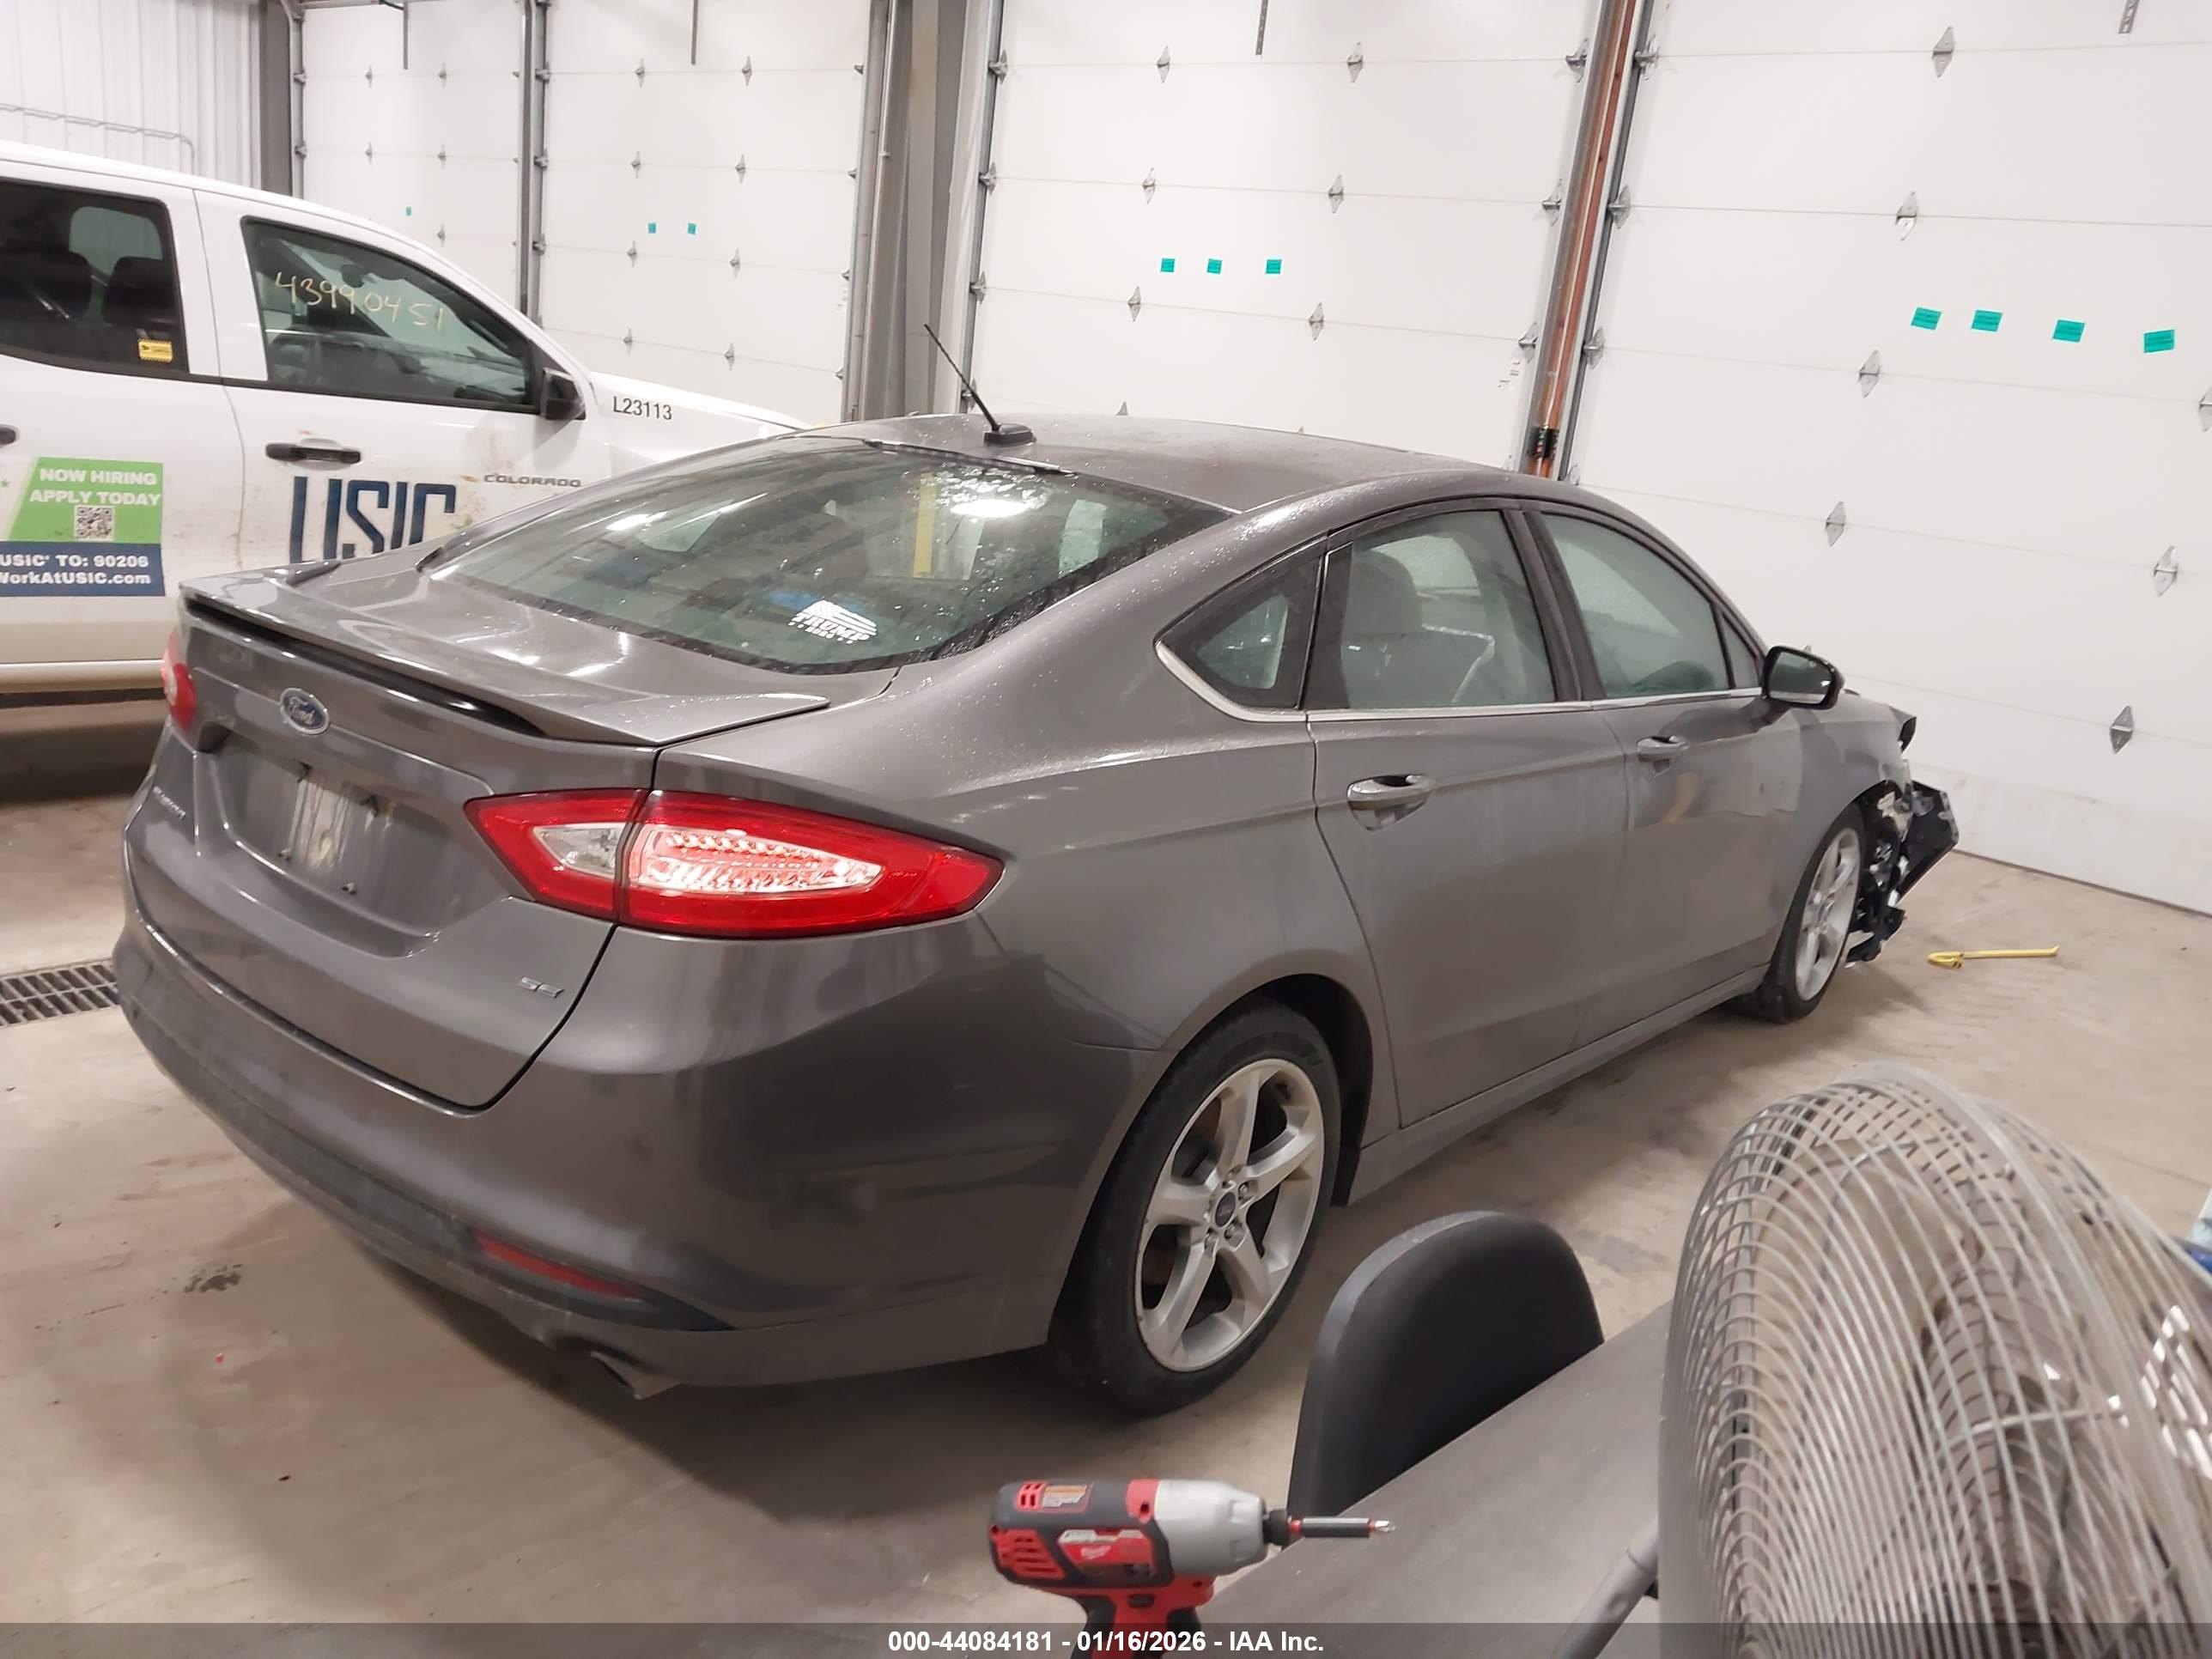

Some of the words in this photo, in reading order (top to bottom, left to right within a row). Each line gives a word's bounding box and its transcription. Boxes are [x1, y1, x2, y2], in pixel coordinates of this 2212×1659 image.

[275, 271, 443, 331] 43990451
[613, 396, 672, 420] L23113
[40, 468, 87, 483] NOW
[91, 470, 157, 485] HIRING
[483, 473, 581, 488] COLORADO
[29, 489, 92, 504] APPLY
[96, 491, 161, 506] TODAY
[55, 555, 89, 567] TO:
